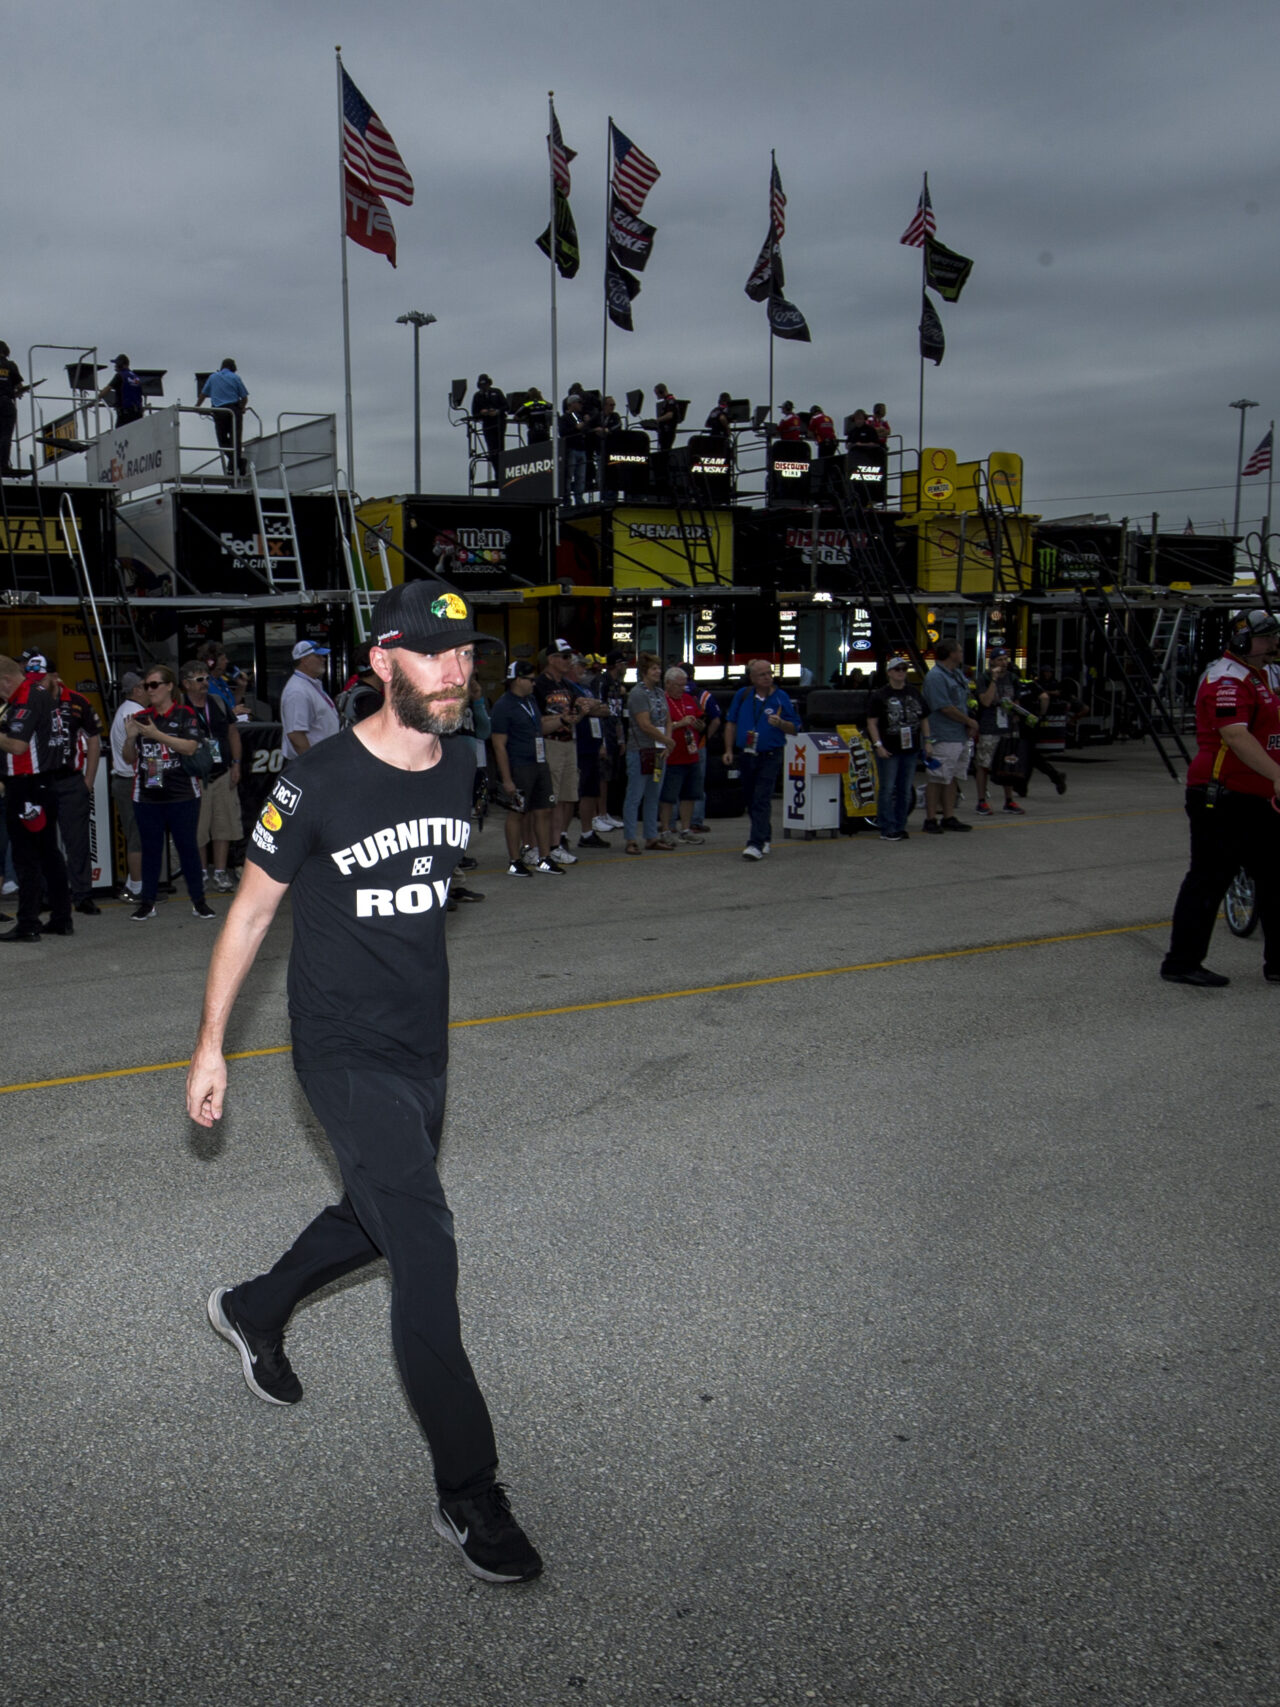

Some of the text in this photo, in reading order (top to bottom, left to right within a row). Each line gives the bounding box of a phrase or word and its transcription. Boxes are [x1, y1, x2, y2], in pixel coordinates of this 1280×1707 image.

[127, 450, 162, 477] RACING
[609, 454, 646, 462] MENARDS
[774, 461, 810, 472] DISCOUNT
[251, 748, 284, 774] 20
[788, 744, 806, 820] FedEx
[331, 817, 470, 876] FURNITUR
